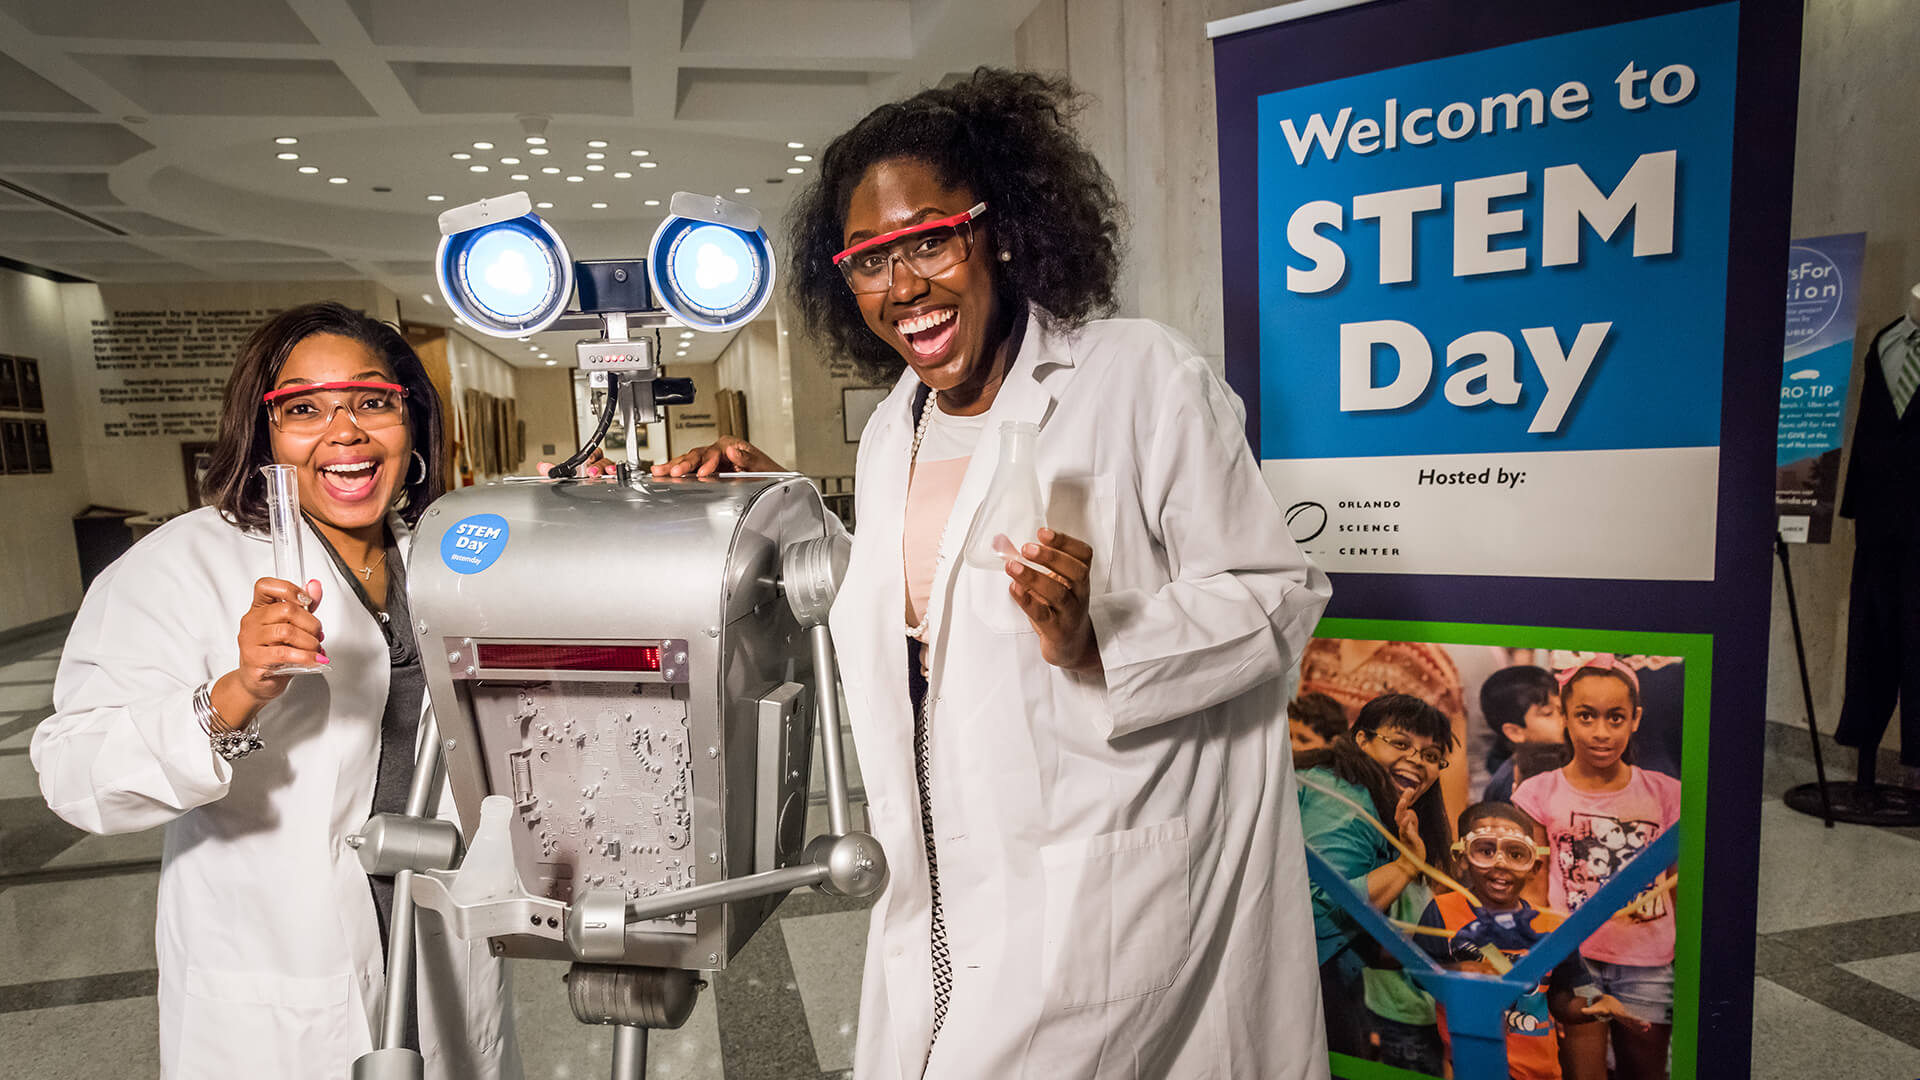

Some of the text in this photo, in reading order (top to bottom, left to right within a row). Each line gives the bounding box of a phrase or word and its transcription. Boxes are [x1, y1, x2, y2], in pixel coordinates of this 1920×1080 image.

[1279, 60, 1696, 166] Welcome to
[1286, 150, 1677, 293] STEM
[1788, 262, 1833, 280] sFor
[1787, 283, 1837, 300] ion
[1340, 320, 1613, 433] Day
[1781, 385, 1834, 399] RO-TIP
[1418, 468, 1526, 488] Hosted by:
[456, 523, 502, 540] STEM
[1339, 524, 1400, 532] SCIENCE
[455, 536, 489, 555] Day
[1339, 548, 1400, 556] CENTER
